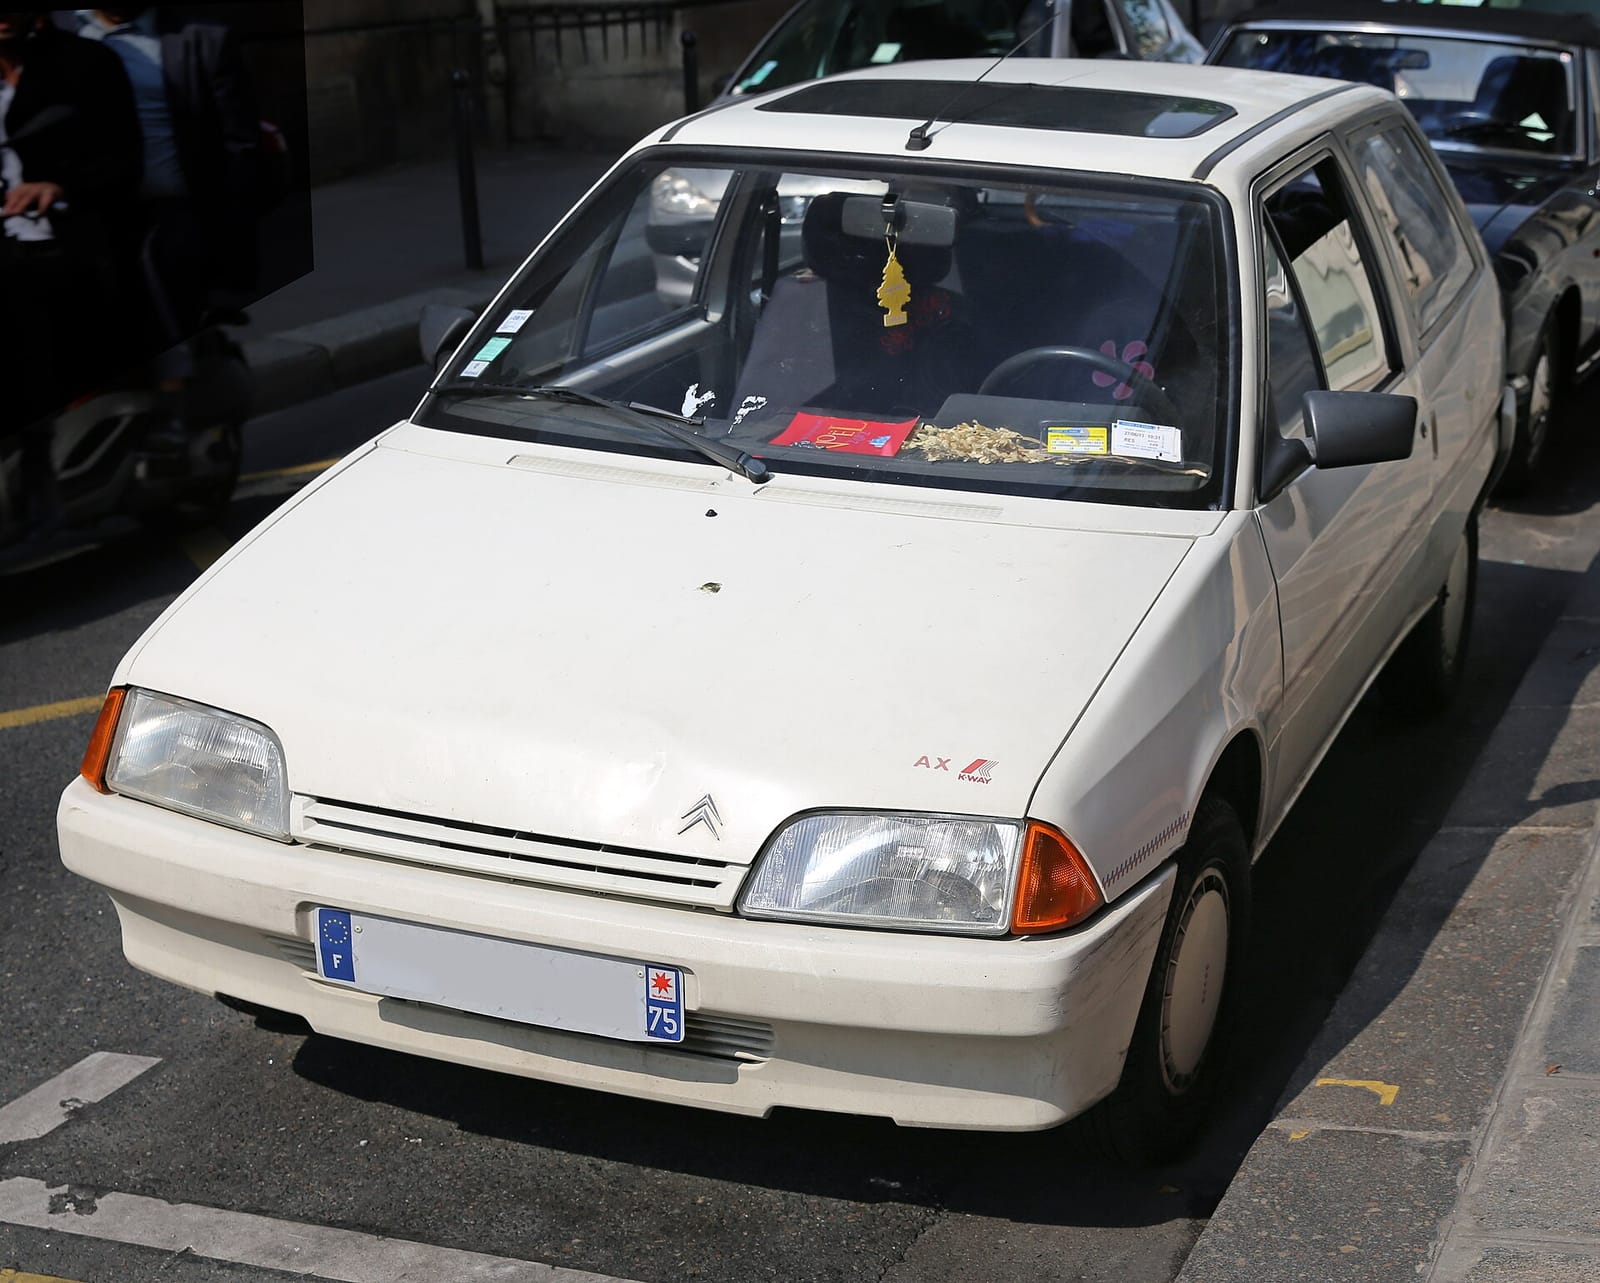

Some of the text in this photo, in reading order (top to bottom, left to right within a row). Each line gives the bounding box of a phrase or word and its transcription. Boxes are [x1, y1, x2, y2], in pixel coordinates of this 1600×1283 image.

[913, 755, 951, 771] AX
[332, 953, 343, 969] F
[648, 1005, 678, 1035] 75
